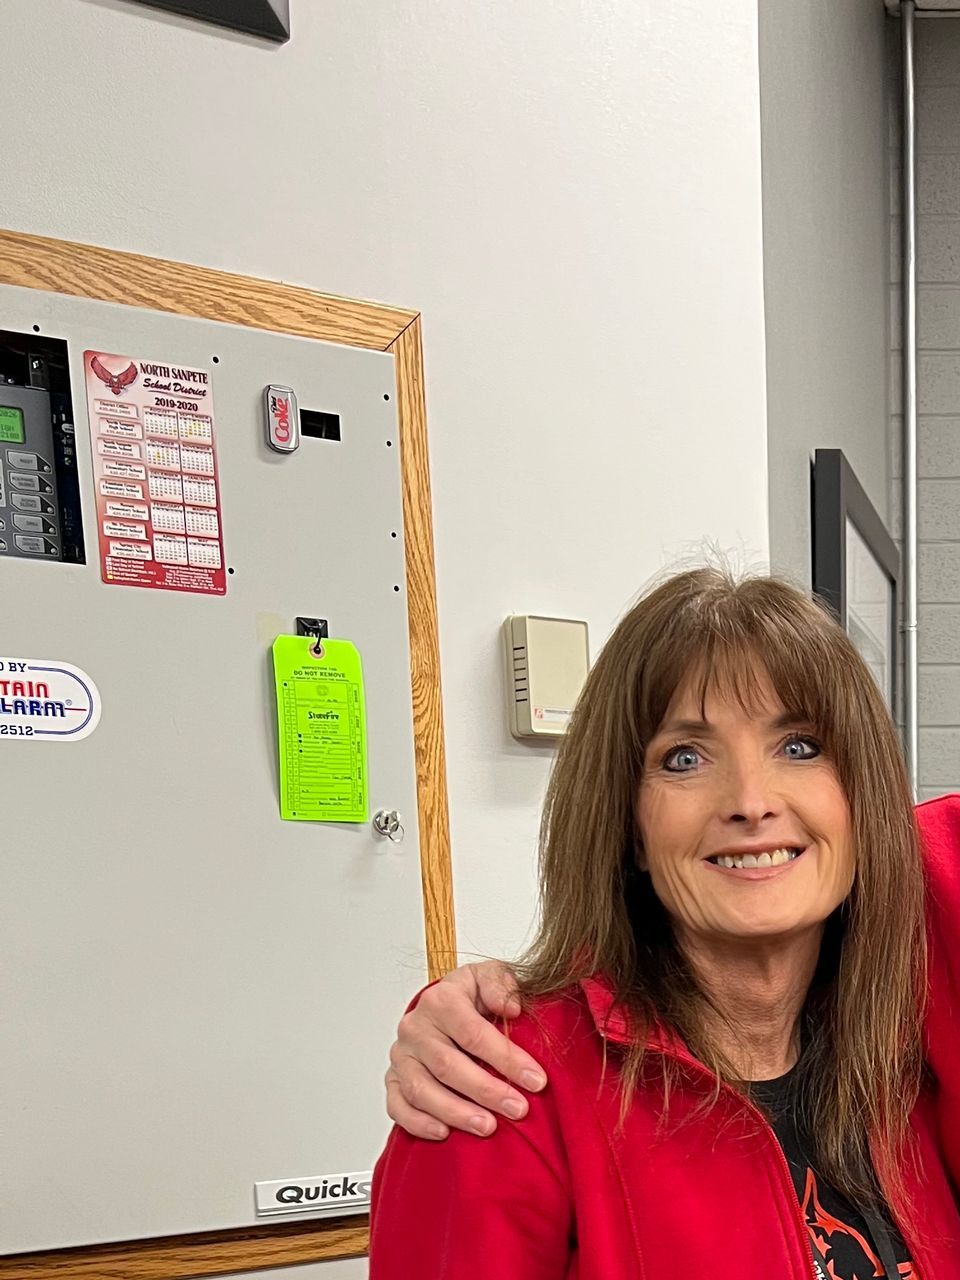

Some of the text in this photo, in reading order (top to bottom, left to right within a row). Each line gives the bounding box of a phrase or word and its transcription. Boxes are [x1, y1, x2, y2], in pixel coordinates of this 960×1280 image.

[140, 363, 208, 384] NORTH SANPETE
[143, 378, 207, 397] School District
[154, 397, 198, 412] 2019-2020
[275, 398, 290, 442] Coke
[8, 662, 27, 673] BY
[0, 725, 34, 736] 2512
